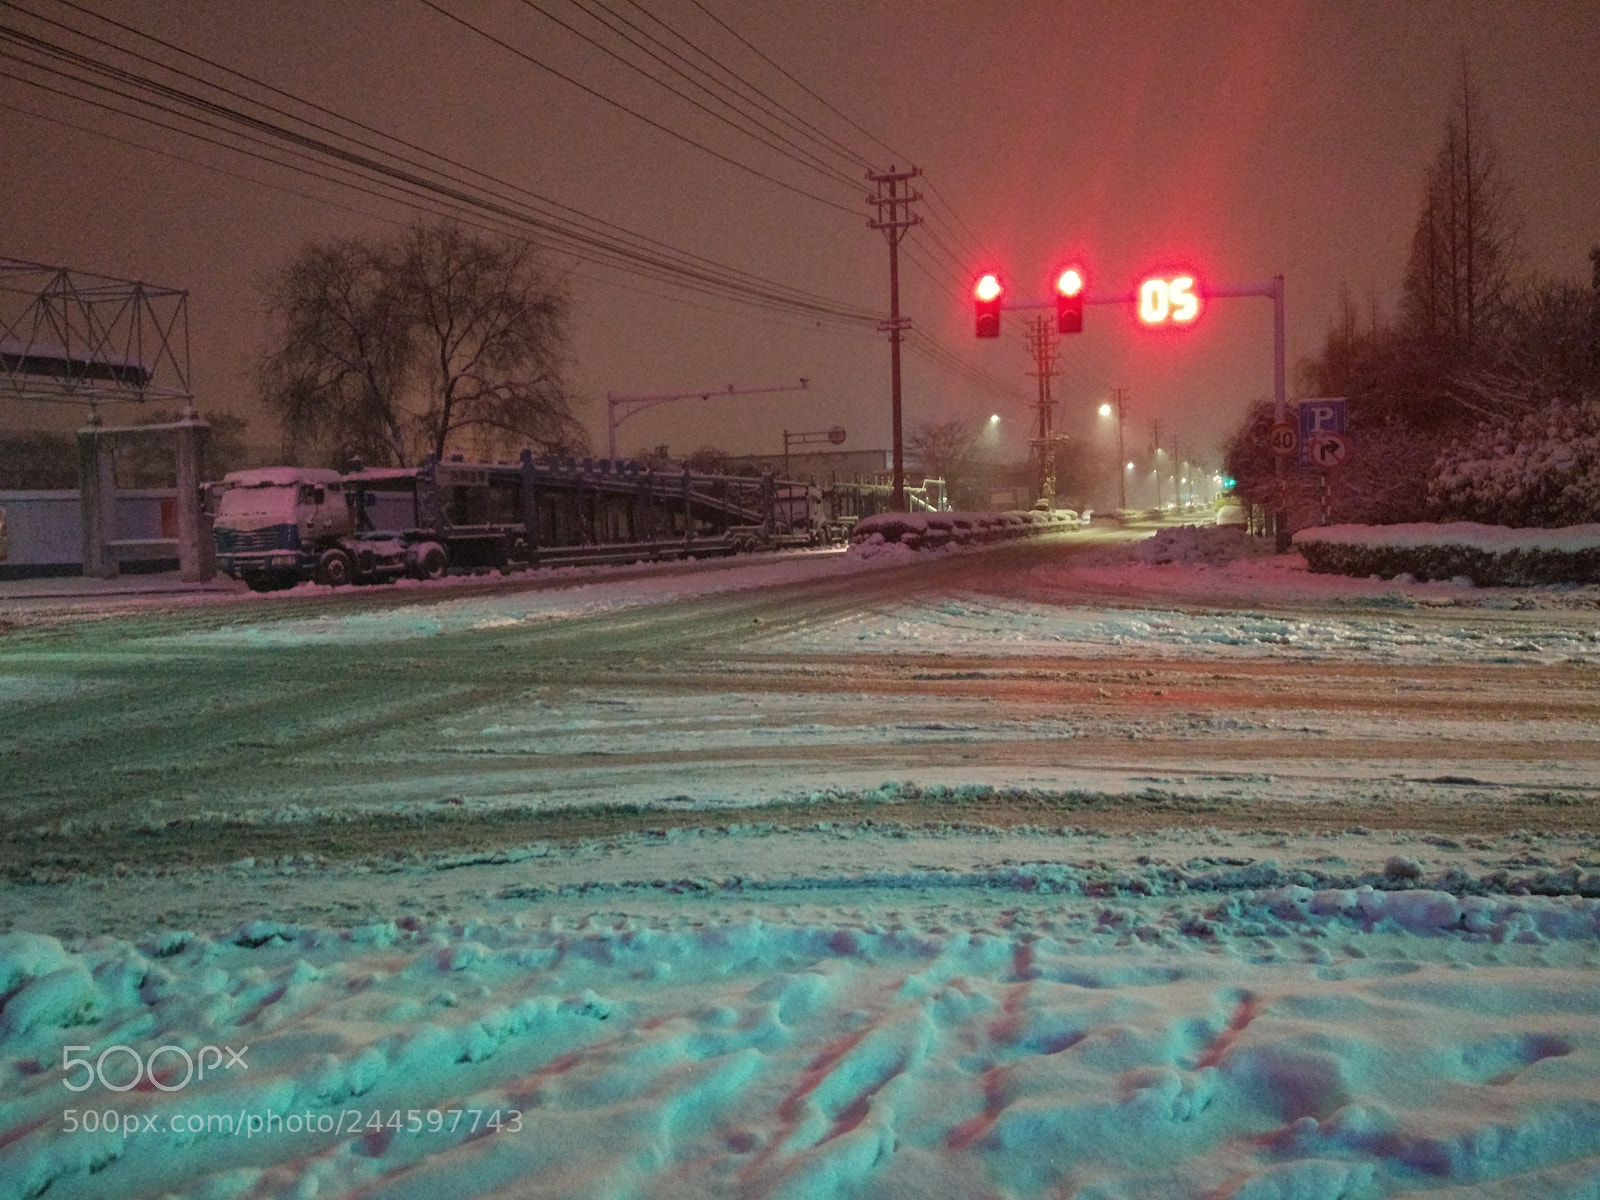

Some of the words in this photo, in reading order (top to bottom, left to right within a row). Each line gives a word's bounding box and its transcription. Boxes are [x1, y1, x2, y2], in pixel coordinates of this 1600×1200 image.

[1140, 276, 1198, 323] 05
[1311, 406, 1334, 432] P
[1272, 431, 1293, 448] 40
